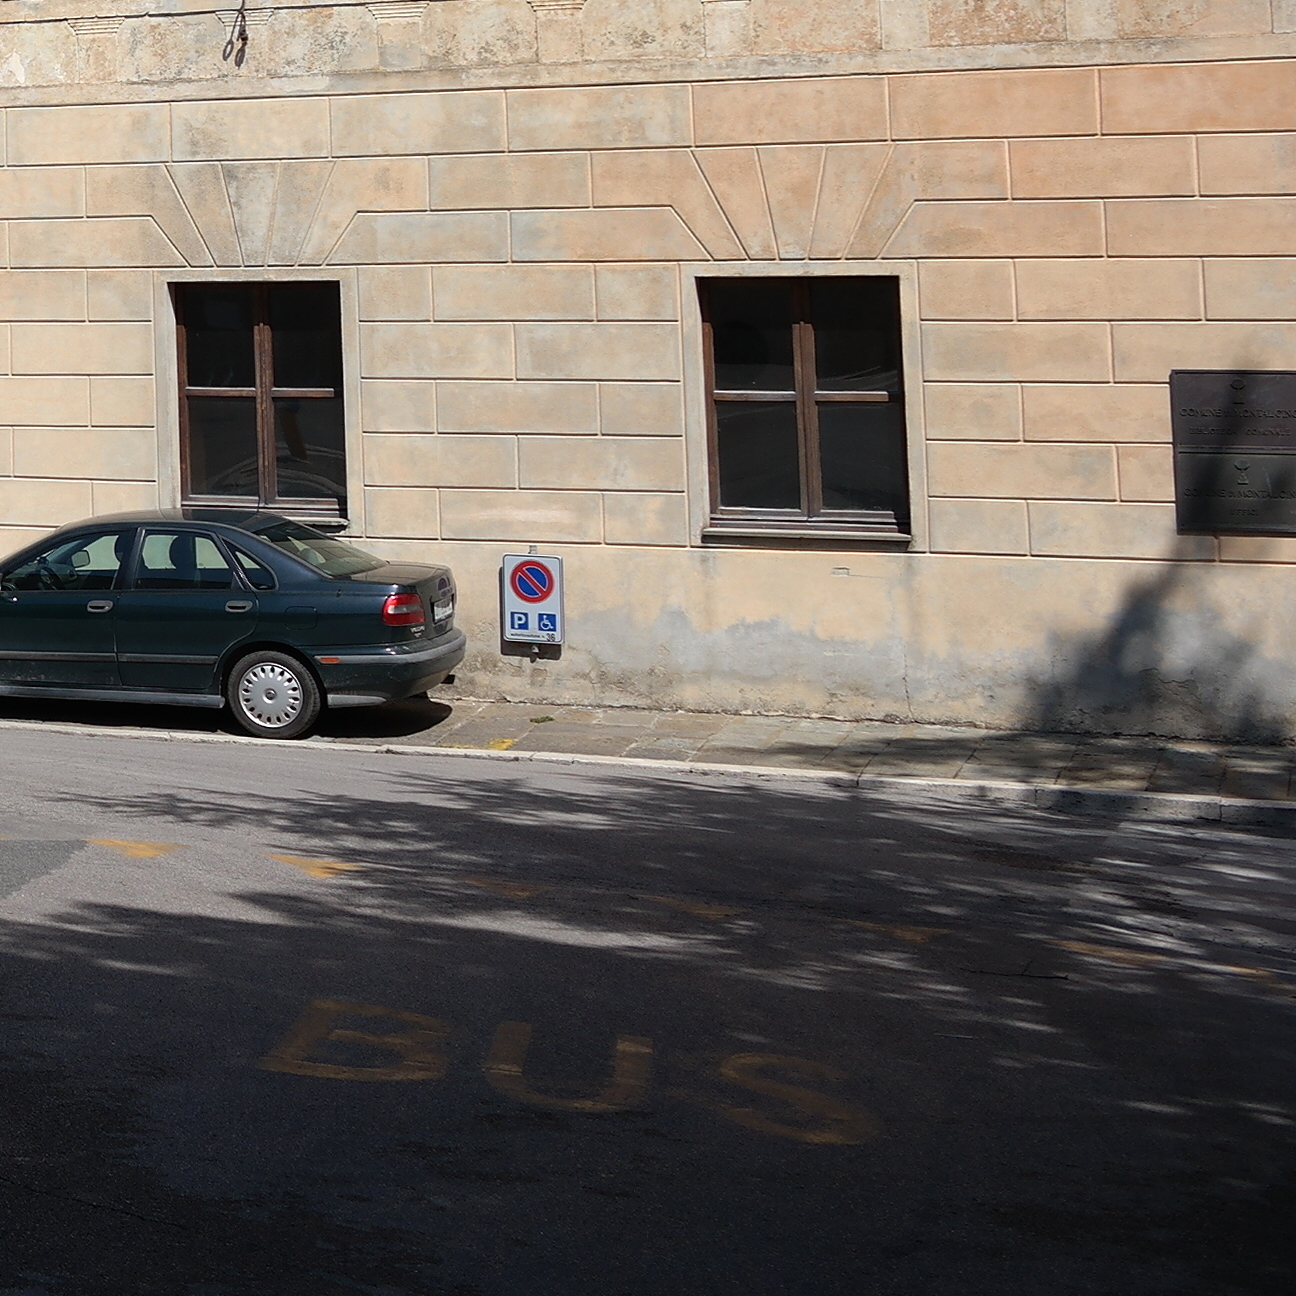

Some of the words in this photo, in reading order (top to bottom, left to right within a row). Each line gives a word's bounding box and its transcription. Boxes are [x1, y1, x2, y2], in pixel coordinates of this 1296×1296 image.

[1179, 407, 1222, 418] COMUNE
[1238, 489, 1296, 500] MONTALCIN
[514, 613, 527, 629] P
[255, 1000, 882, 1144] BUS
